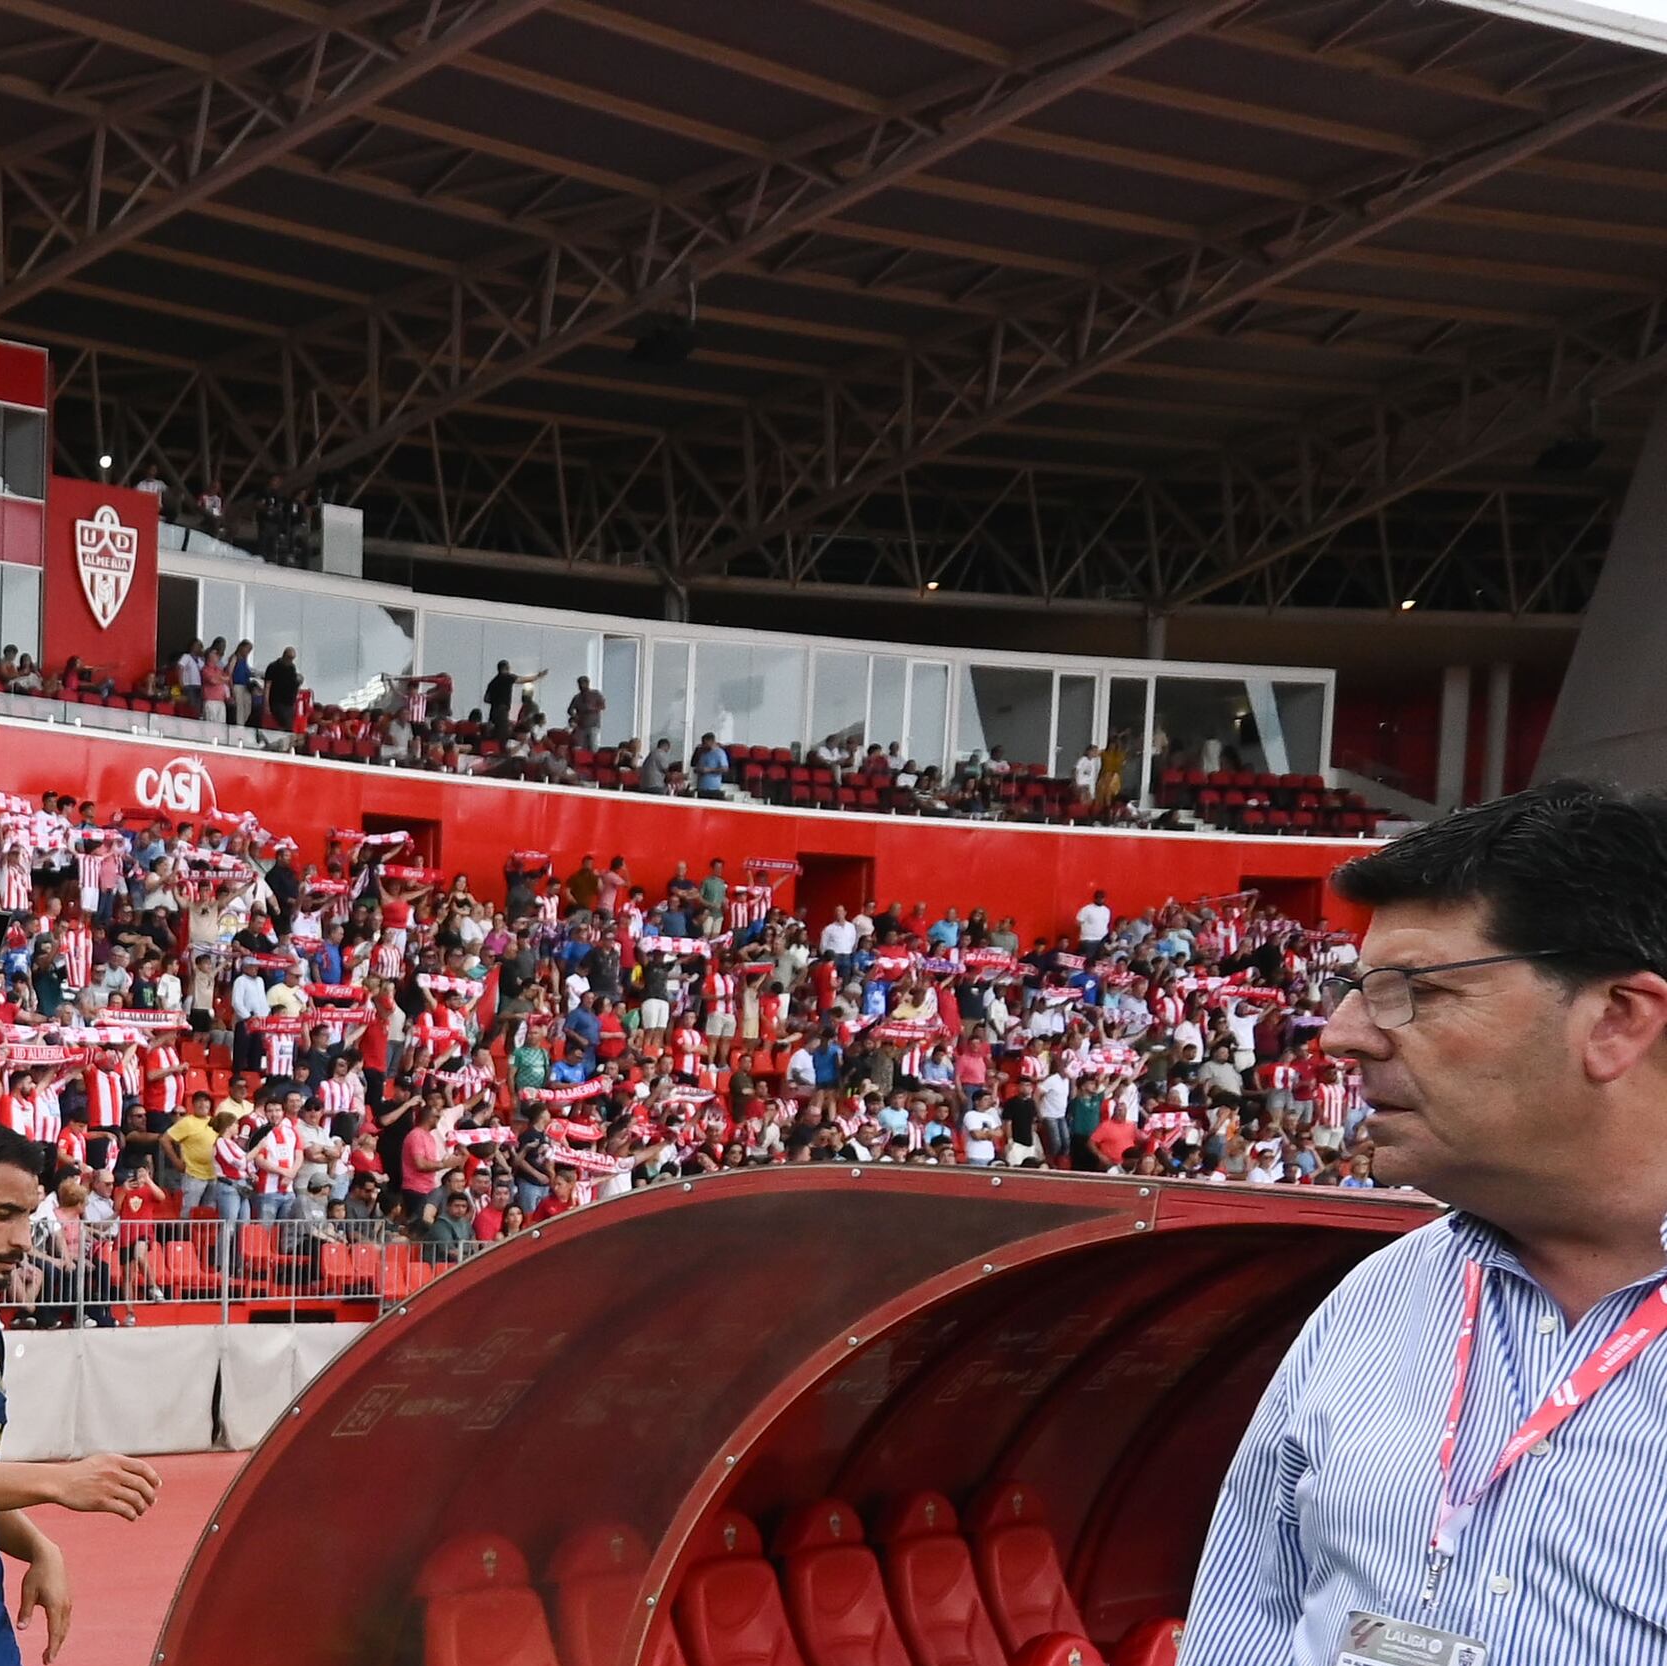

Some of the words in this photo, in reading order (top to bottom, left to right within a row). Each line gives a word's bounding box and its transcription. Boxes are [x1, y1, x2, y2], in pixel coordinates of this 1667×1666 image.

[82, 554, 129, 573] ALMERIA
[136, 767, 201, 813] CASI
[1384, 1628, 1428, 1650] LALIGA
